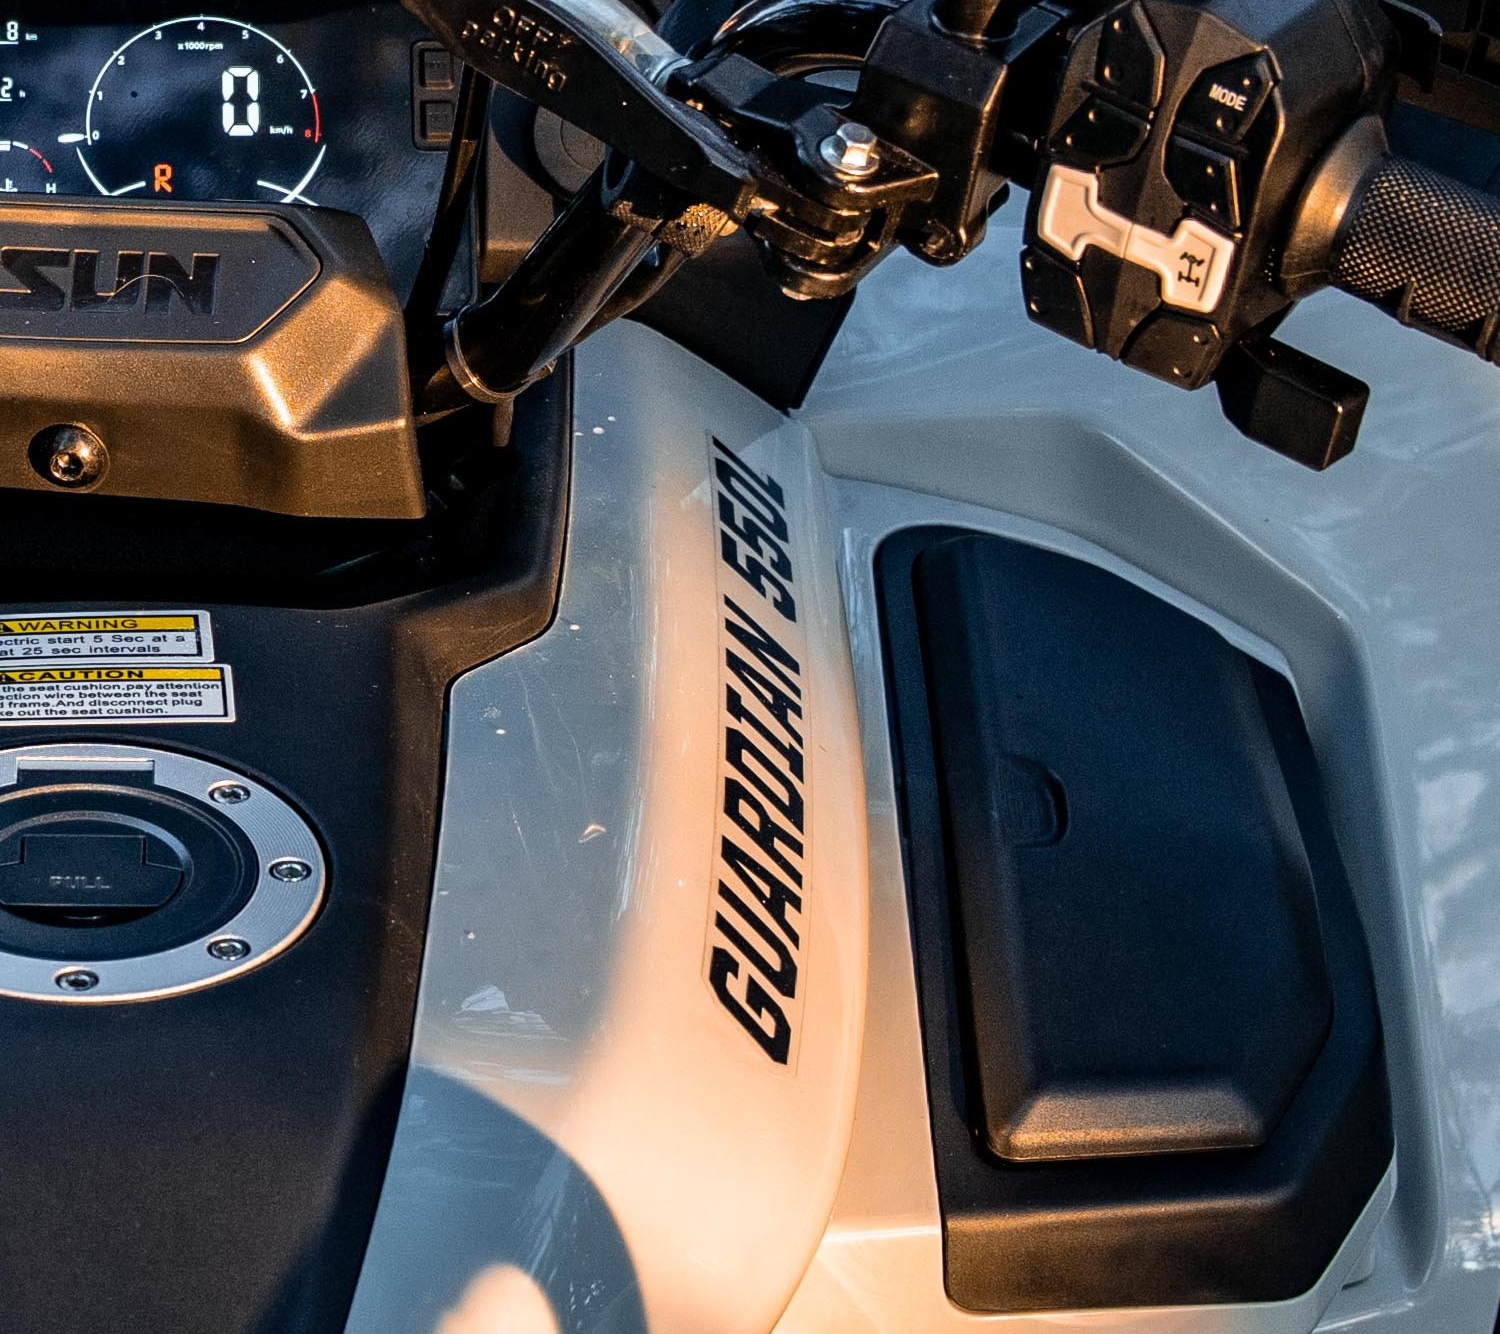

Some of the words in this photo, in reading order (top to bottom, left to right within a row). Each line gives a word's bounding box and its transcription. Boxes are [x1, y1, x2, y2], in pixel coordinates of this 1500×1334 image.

[7, 21, 18, 40] 8
[197, 22, 205, 31] 4
[155, 31, 161, 40] 3
[242, 30, 249, 40] 5
[118, 56, 125, 65] 2
[277, 54, 284, 63] 6
[0, 77, 13, 98] 2
[19, 90, 26, 98] h
[97, 91, 102, 100] 1
[300, 90, 307, 99] 7
[1208, 82, 1248, 113] MODE
[222, 67, 259, 136] 0
[92, 131, 99, 140] 0
[269, 126, 293, 135] km/h
[304, 130, 311, 138] 8
[154, 164, 172, 193] R
[46, 184, 56, 193] H
[711, 435, 798, 623] 550L
[19, 619, 138, 632] WARNING
[47, 635, 85, 645] start
[93, 635, 103, 643] 5
[112, 634, 144, 643] Sec
[151, 634, 167, 643] at
[22, 647, 43, 656] 25
[89, 644, 160, 653] intervals
[19, 669, 144, 682] CAUTION
[2, 685, 25, 693] the
[29, 684, 60, 692] seat
[155, 682, 219, 690] attention
[78, 691, 142, 699] between
[145, 690, 168, 698] the
[173, 690, 202, 698] seat
[88, 698, 167, 707] disconnect
[172, 698, 202, 707] plug
[708, 595, 804, 1065] GUARDIAN
